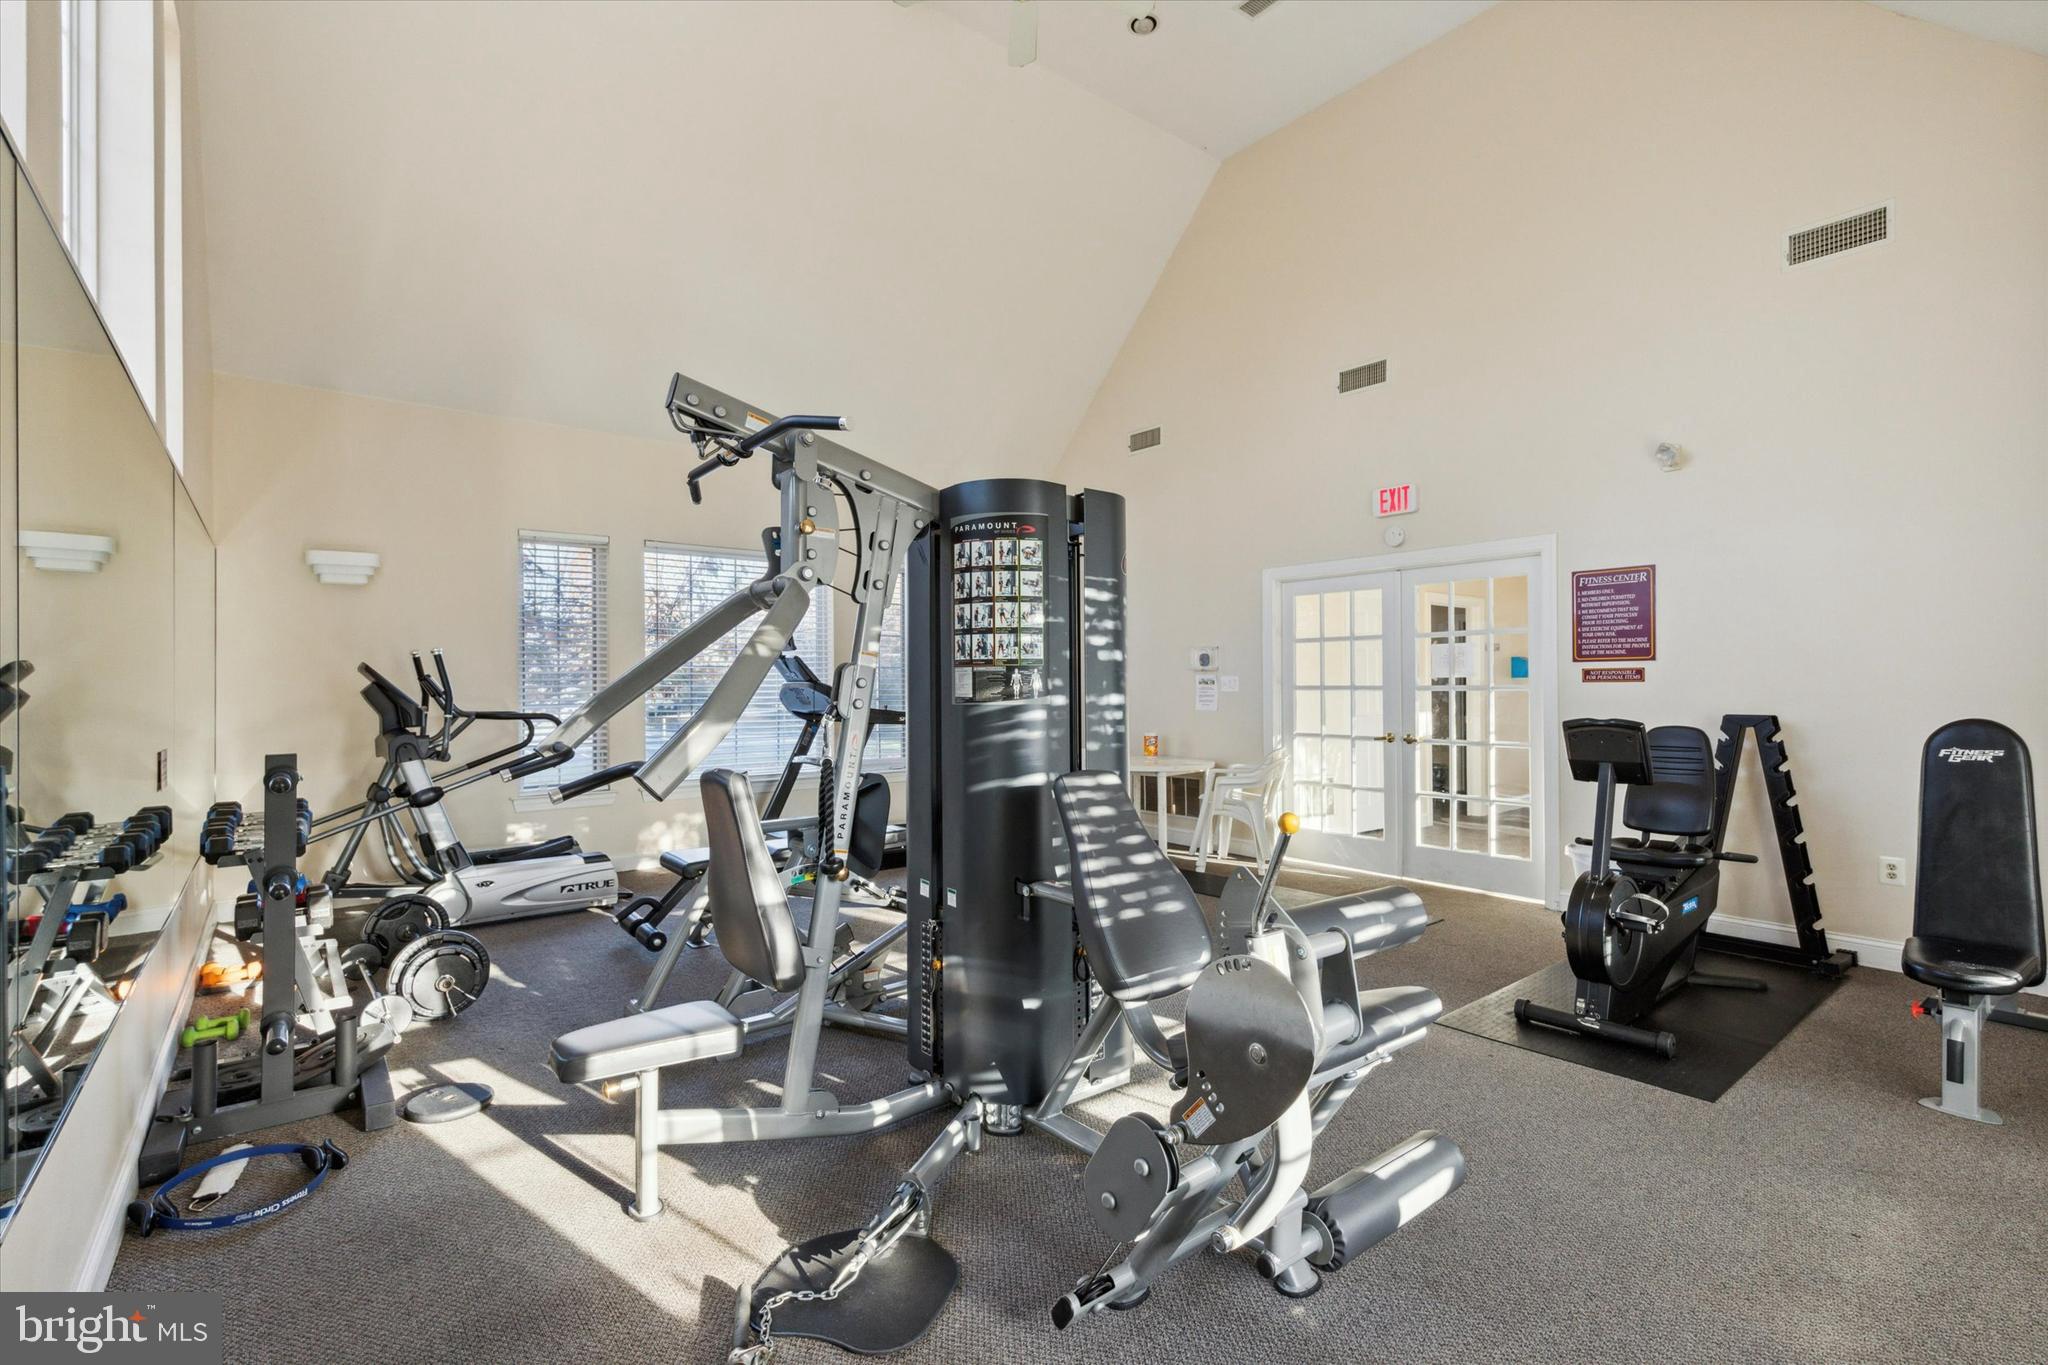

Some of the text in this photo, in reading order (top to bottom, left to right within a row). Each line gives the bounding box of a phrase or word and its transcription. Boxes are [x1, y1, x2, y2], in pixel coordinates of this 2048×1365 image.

[1380, 485, 1410, 513] EXIT
[954, 522, 1017, 534] PARAMOUNT
[1579, 572, 1648, 587] FITNESS CENTER
[1938, 747, 2005, 757] FITNESS
[575, 879, 615, 891] TRUE
[281, 1187, 308, 1208] Fitness
[253, 1202, 281, 1217] Circle
